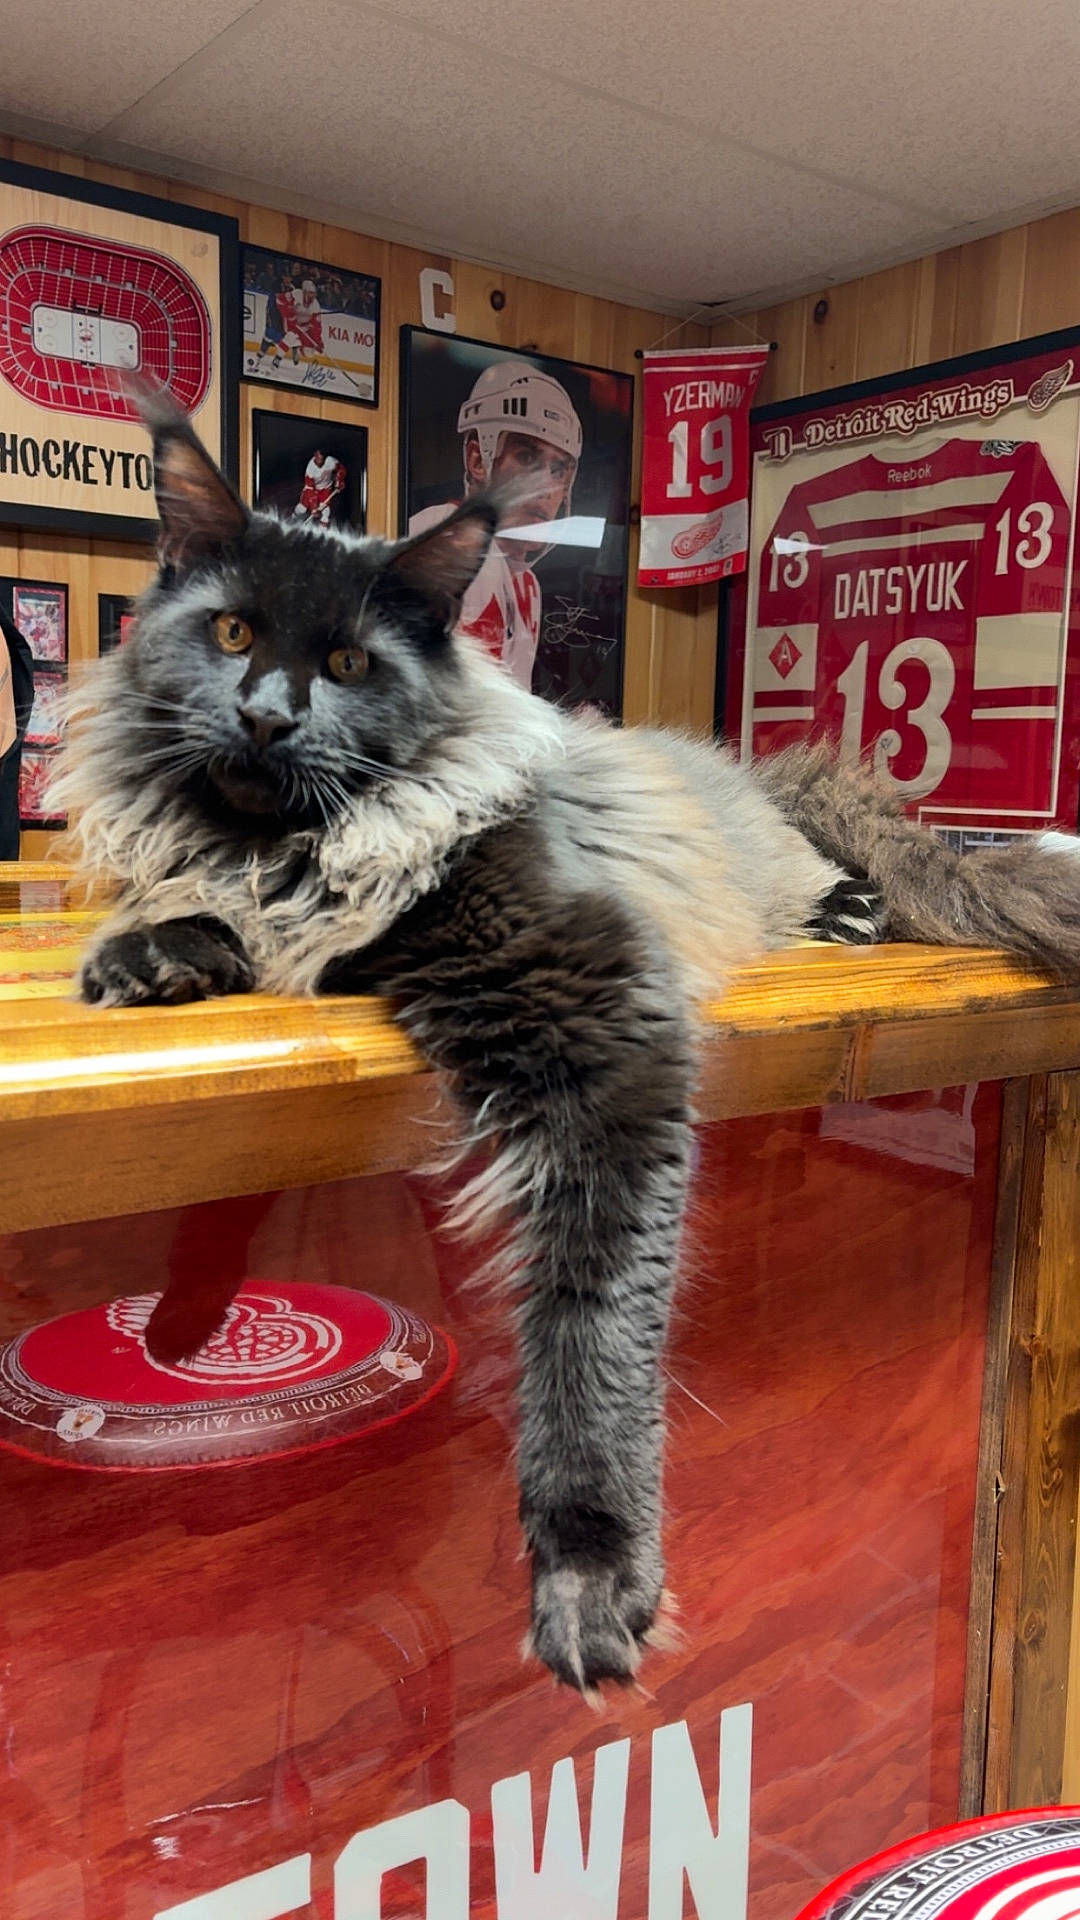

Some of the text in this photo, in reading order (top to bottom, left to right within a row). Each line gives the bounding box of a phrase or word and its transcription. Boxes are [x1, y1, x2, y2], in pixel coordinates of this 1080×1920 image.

[419, 268, 456, 335] C
[328, 325, 350, 343] KIA
[663, 380, 746, 417] YZERMAN
[805, 383, 1011, 443] Detroit Red Wings
[667, 414, 733, 499] 19
[887, 463, 933, 484] Reebok
[994, 501, 1055, 576] 13
[833, 559, 968, 620] DATSYUK
[837, 637, 956, 802] 13
[907, 1828, 1040, 1884] DETROIT
